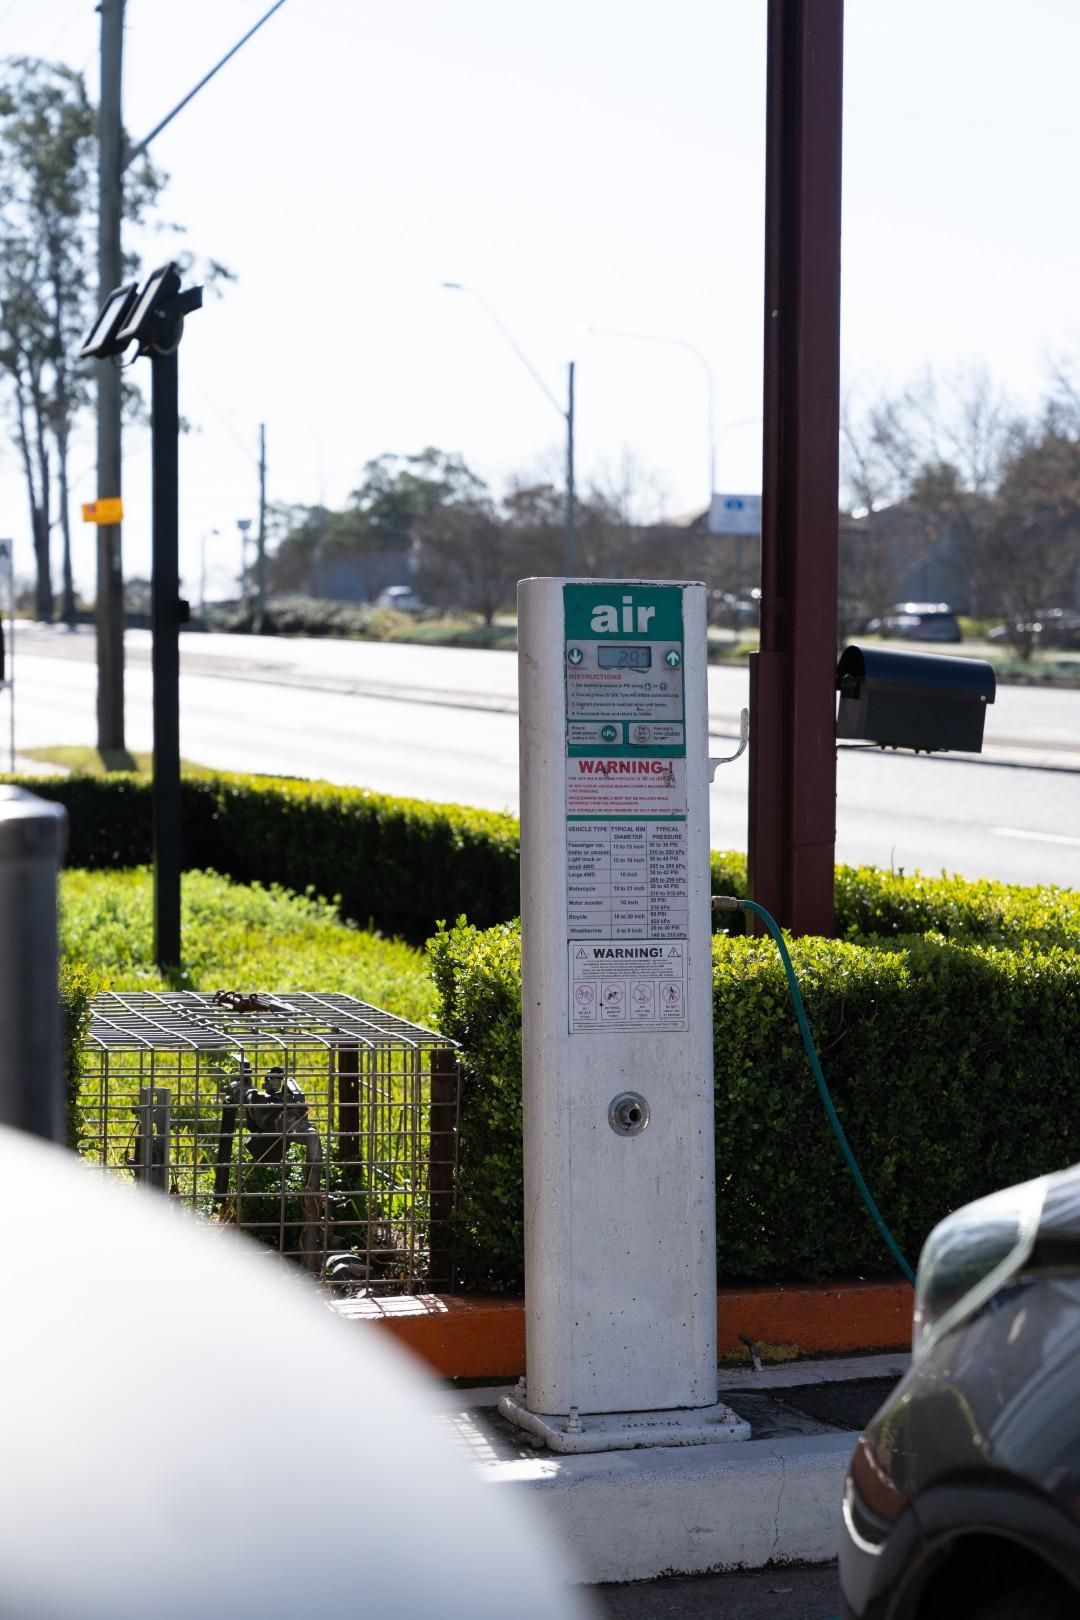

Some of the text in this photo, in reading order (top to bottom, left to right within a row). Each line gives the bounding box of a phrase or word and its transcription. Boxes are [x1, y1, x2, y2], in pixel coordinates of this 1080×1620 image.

[590, 595, 656, 632] air
[579, 760, 662, 774] WARNING
[593, 948, 663, 958] WARNING!
